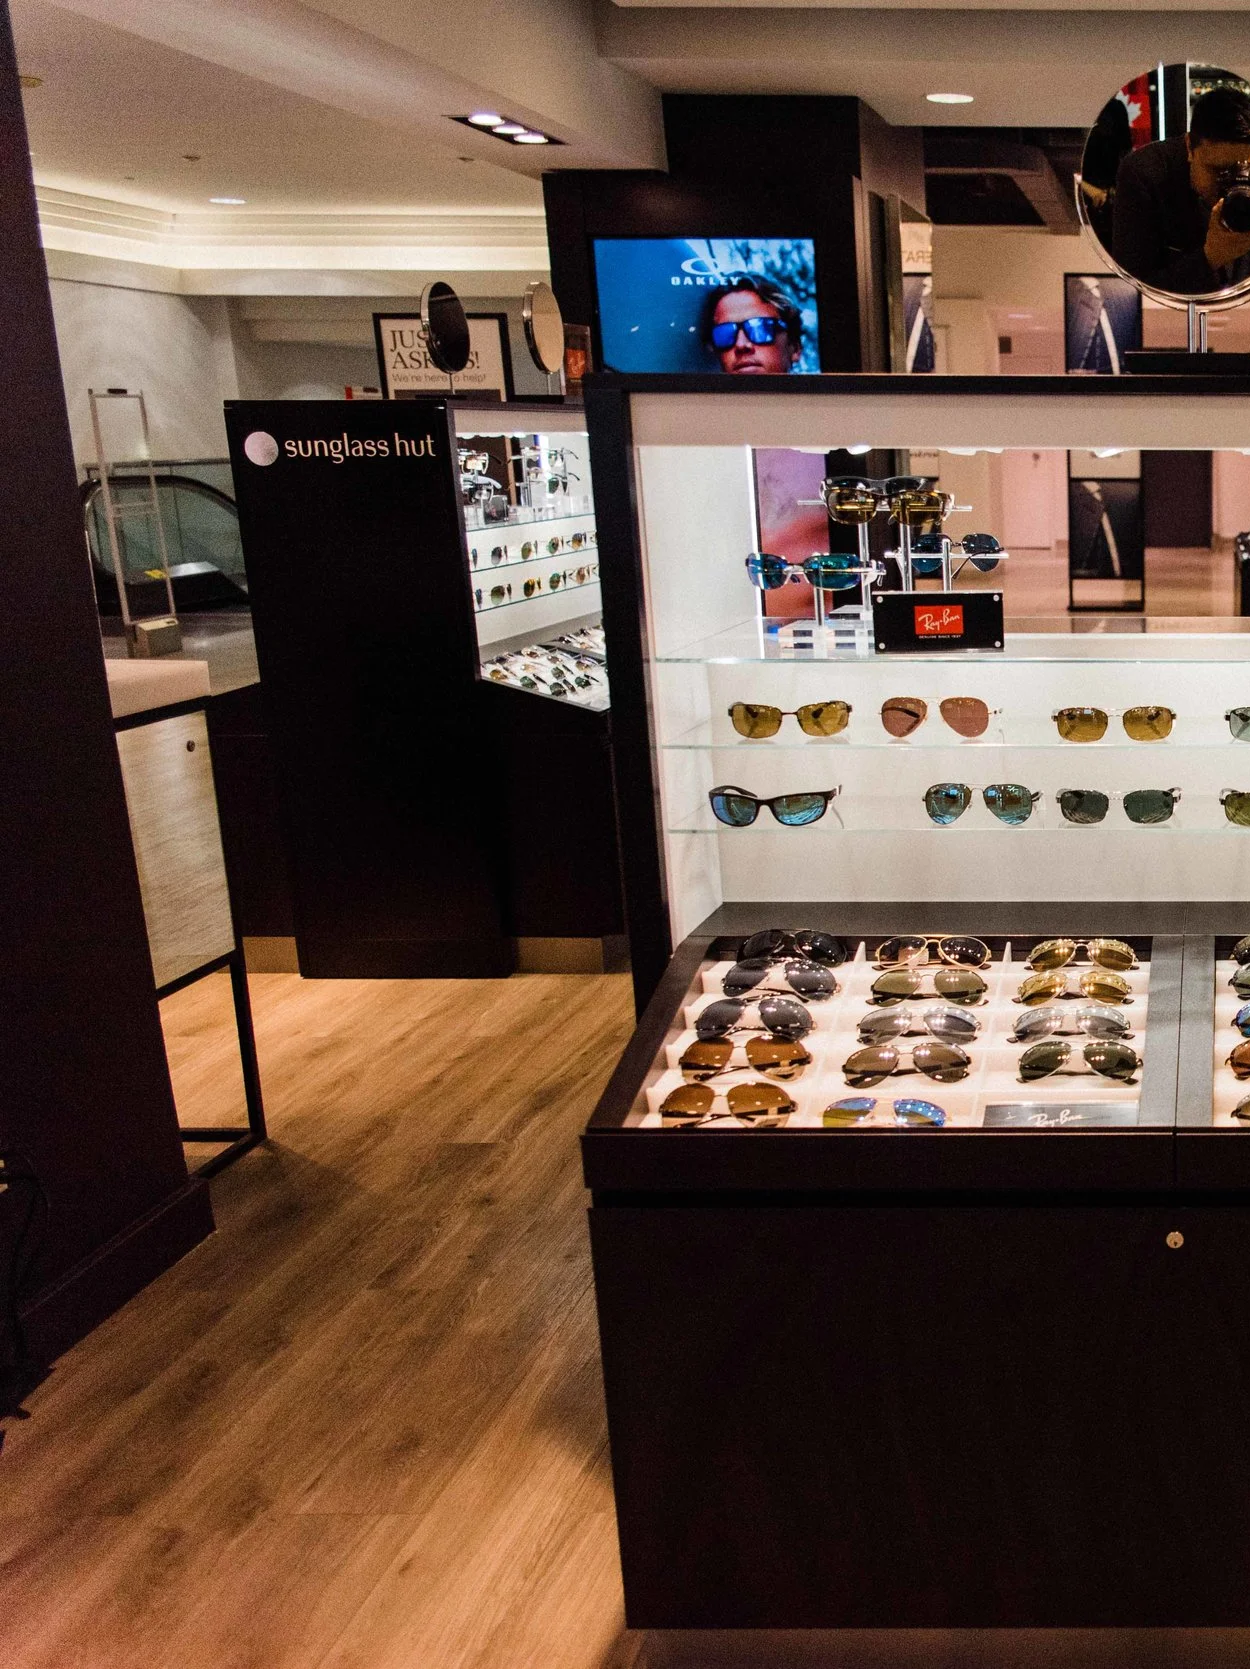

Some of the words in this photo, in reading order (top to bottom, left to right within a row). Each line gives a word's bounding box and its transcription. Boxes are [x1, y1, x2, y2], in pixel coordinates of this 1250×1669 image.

[671, 276, 740, 286] OAKLEY
[390, 330, 429, 352] JUS
[284, 432, 389, 465] sunglass
[394, 432, 437, 458] hut
[918, 608, 960, 631] Ray-Ban
